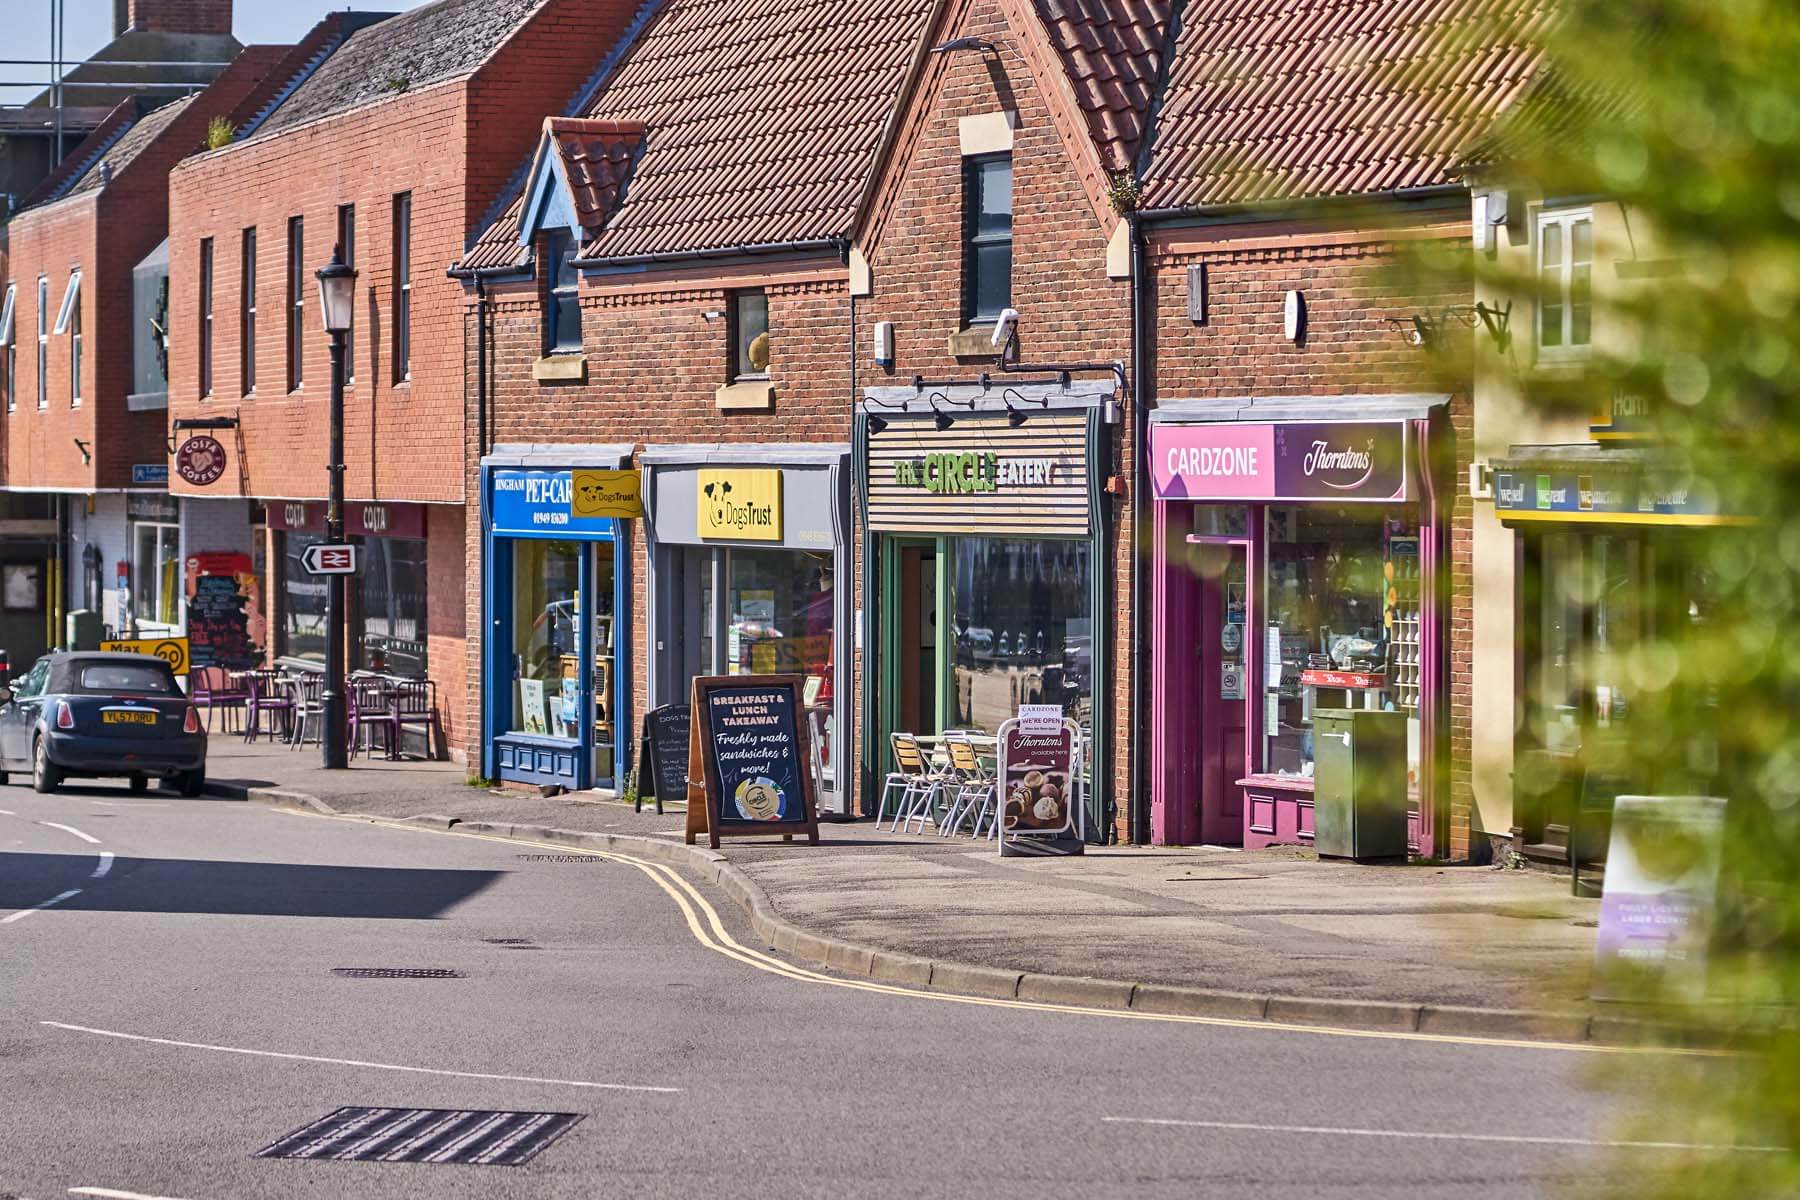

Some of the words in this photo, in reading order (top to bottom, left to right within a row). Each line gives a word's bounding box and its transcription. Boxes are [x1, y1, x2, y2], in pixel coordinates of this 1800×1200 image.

[185, 440, 217, 453] COSTA
[1167, 447, 1258, 476] CARDZONE
[1304, 440, 1370, 476] Thorntons
[182, 466, 220, 481] COFFEE
[894, 460, 919, 485] THE
[923, 452, 996, 492] CIRCLE
[999, 460, 1052, 485] EATERY
[284, 504, 305, 528] COSTA
[363, 506, 386, 532] COSTA
[110, 643, 140, 653] Max
[713, 695, 775, 705] BREAKFAST
[776, 694, 785, 703] &
[732, 705, 768, 715] LUNCH
[722, 716, 779, 726] TAKEAWAY
[716, 732, 758, 746] Freshly
[760, 731, 789, 743] made
[1013, 735, 1063, 749] Thorntons
[720, 747, 779, 761] sandwiches
[782, 747, 789, 758] &
[740, 761, 770, 774] more!
